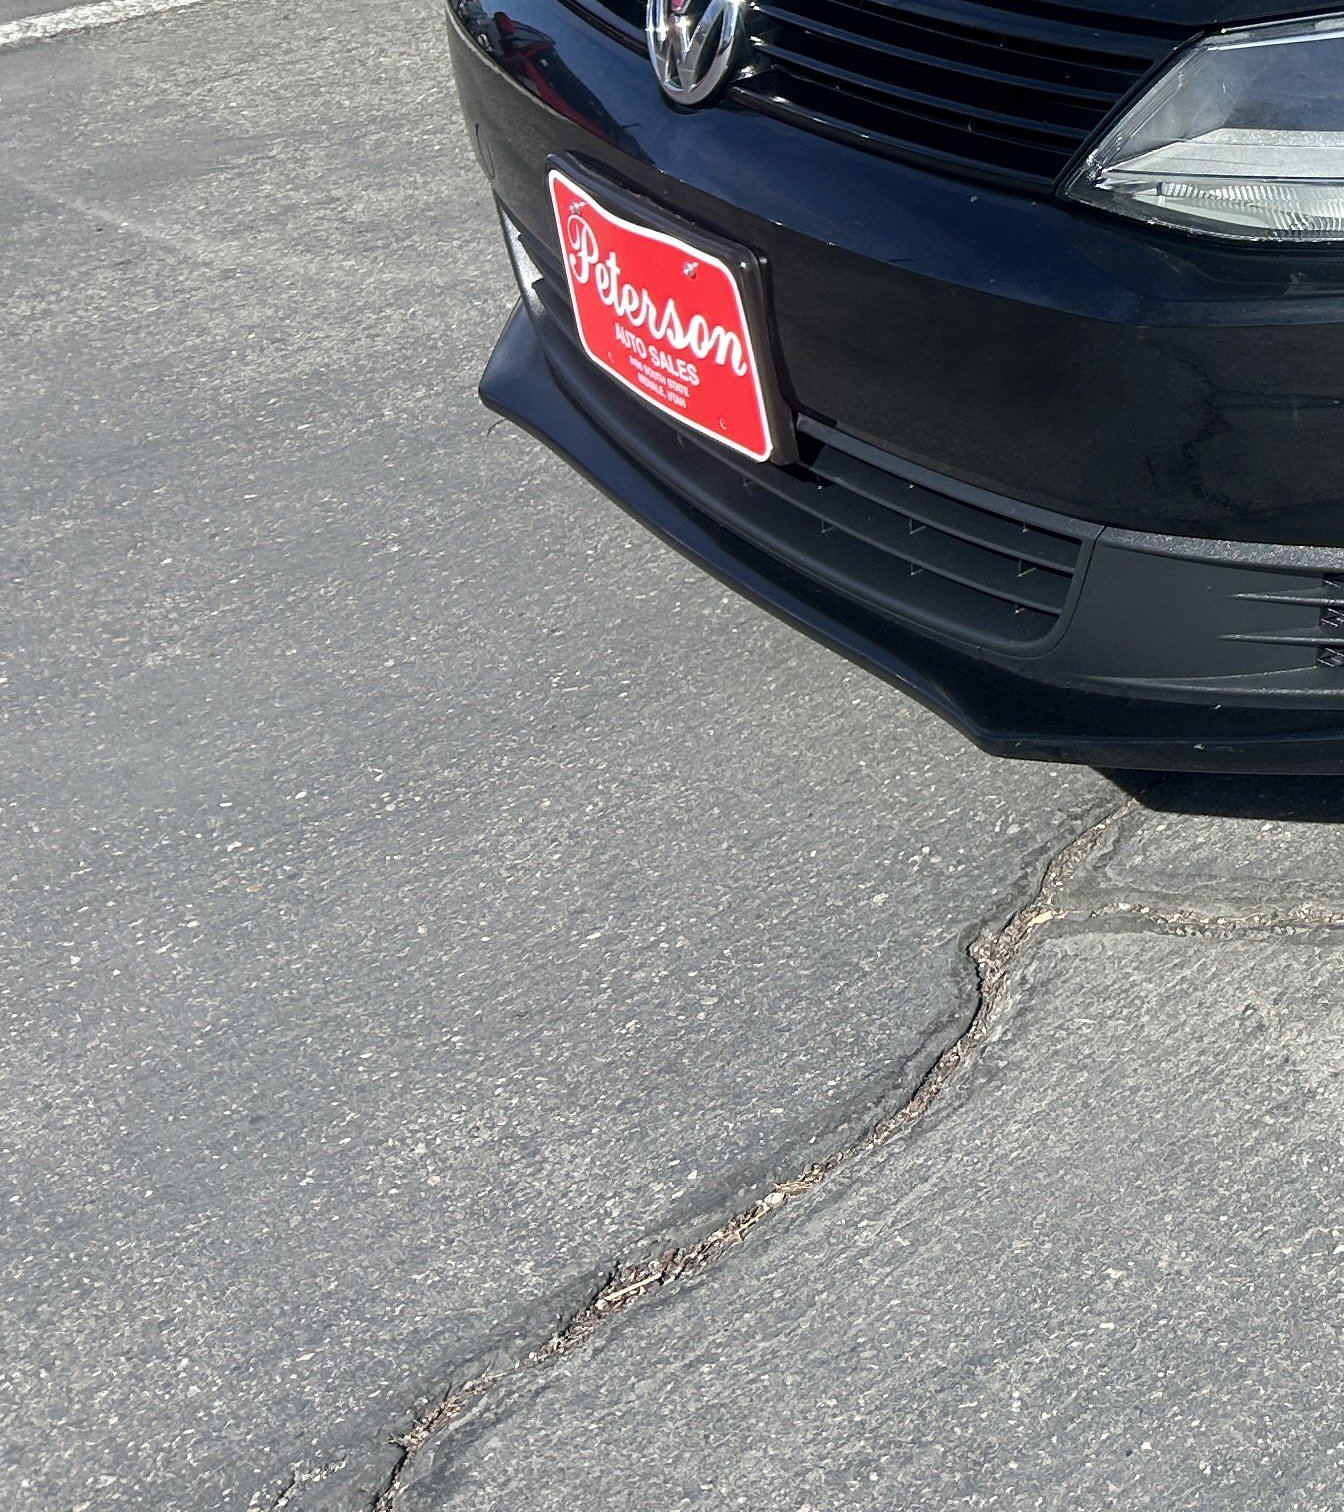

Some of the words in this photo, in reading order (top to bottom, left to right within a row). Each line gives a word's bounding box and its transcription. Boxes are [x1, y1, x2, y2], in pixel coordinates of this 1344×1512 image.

[567, 214, 747, 377] Peterson
[615, 322, 647, 359] AUTO
[649, 345, 700, 386] SALES
